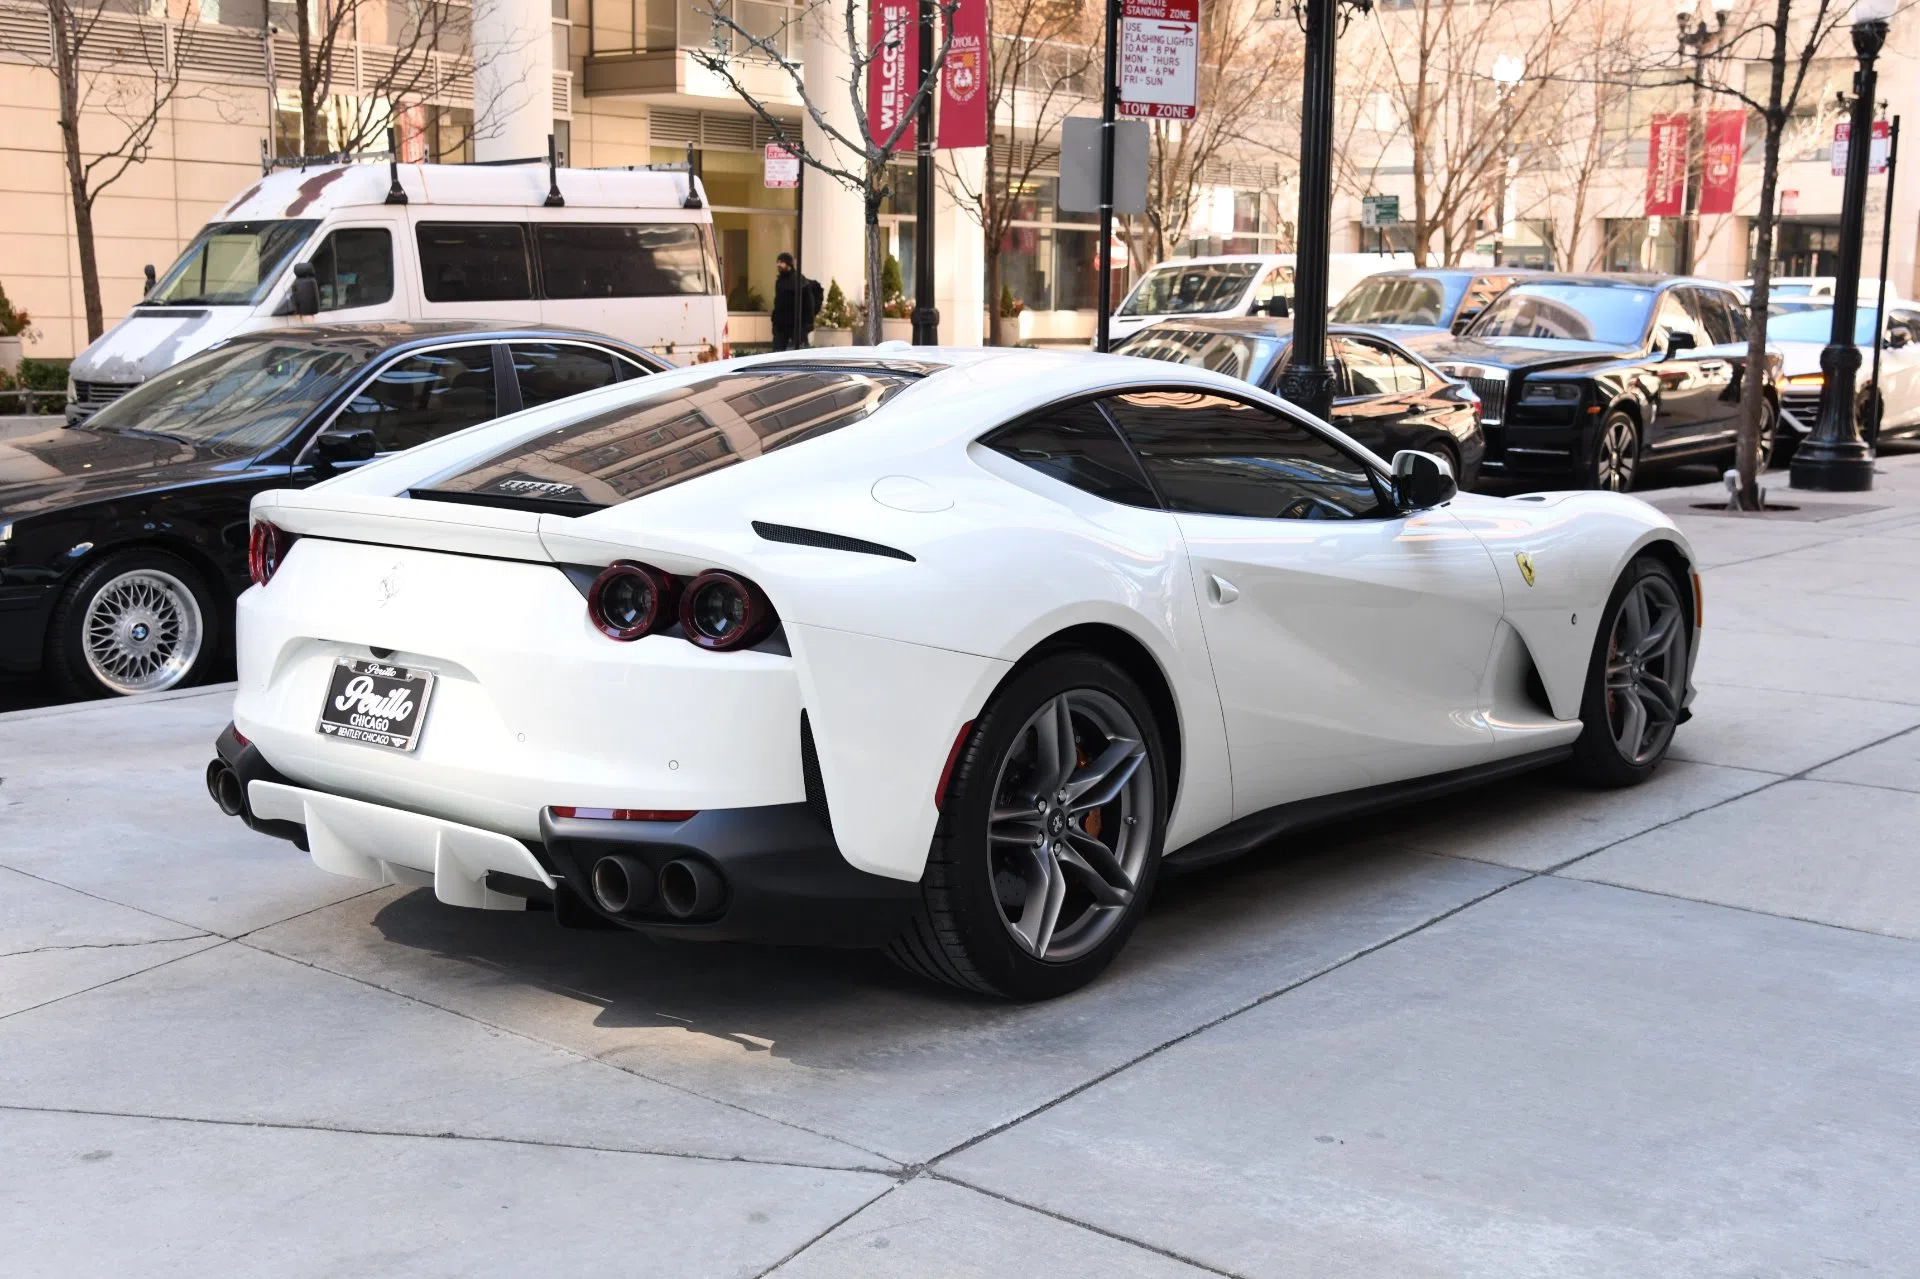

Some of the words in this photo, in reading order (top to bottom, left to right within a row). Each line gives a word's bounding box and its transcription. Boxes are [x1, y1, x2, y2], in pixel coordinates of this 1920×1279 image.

[1126, 6, 1165, 17] STANDING
[1169, 8, 1191, 20] ZONE
[1125, 22, 1143, 33] USE
[951, 35, 980, 48] OYOLA
[1125, 33, 1165, 44] FLASHING
[1166, 36, 1194, 47] LIGHTS
[1125, 43, 1134, 53] 10
[1135, 44, 1148, 53] AM
[1156, 45, 1162, 54] 8
[1164, 46, 1177, 55] PM
[1124, 54, 1143, 64] MON
[1152, 55, 1180, 67] THURS
[881, 5, 898, 131] WELCOME
[896, 51, 906, 92] TOWER
[1124, 64, 1133, 74] 10
[1134, 65, 1147, 75] AM
[1155, 67, 1161, 76] 6
[1162, 67, 1175, 77] PM
[1124, 74, 1138, 84] FRI
[1145, 76, 1163, 86] SUN
[1123, 102, 1151, 116] TOW
[1155, 104, 1190, 118] ZONE
[364, 663, 397, 677] Perillo
[335, 675, 414, 722] Perillo
[350, 714, 389, 732] CHICAGO
[338, 727, 361, 740] BENTLEY
[362, 731, 390, 744] CHICAGO
